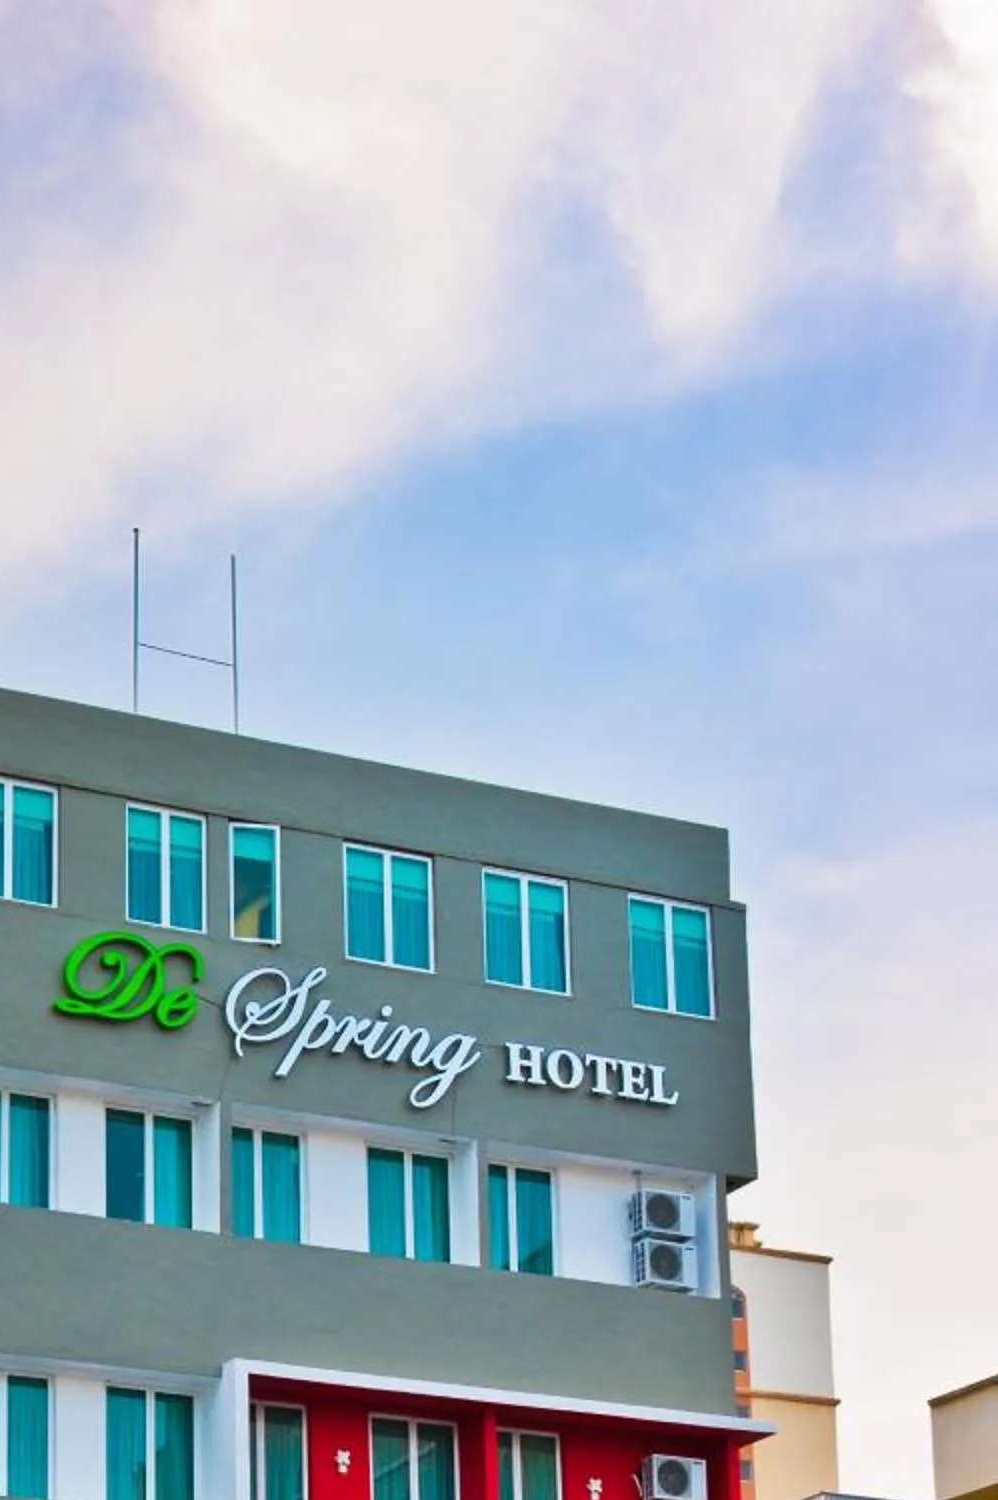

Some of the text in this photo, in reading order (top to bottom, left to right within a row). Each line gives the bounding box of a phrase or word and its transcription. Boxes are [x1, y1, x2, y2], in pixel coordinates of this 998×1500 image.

[52, 928, 680, 1108] De Spring HOTEL
